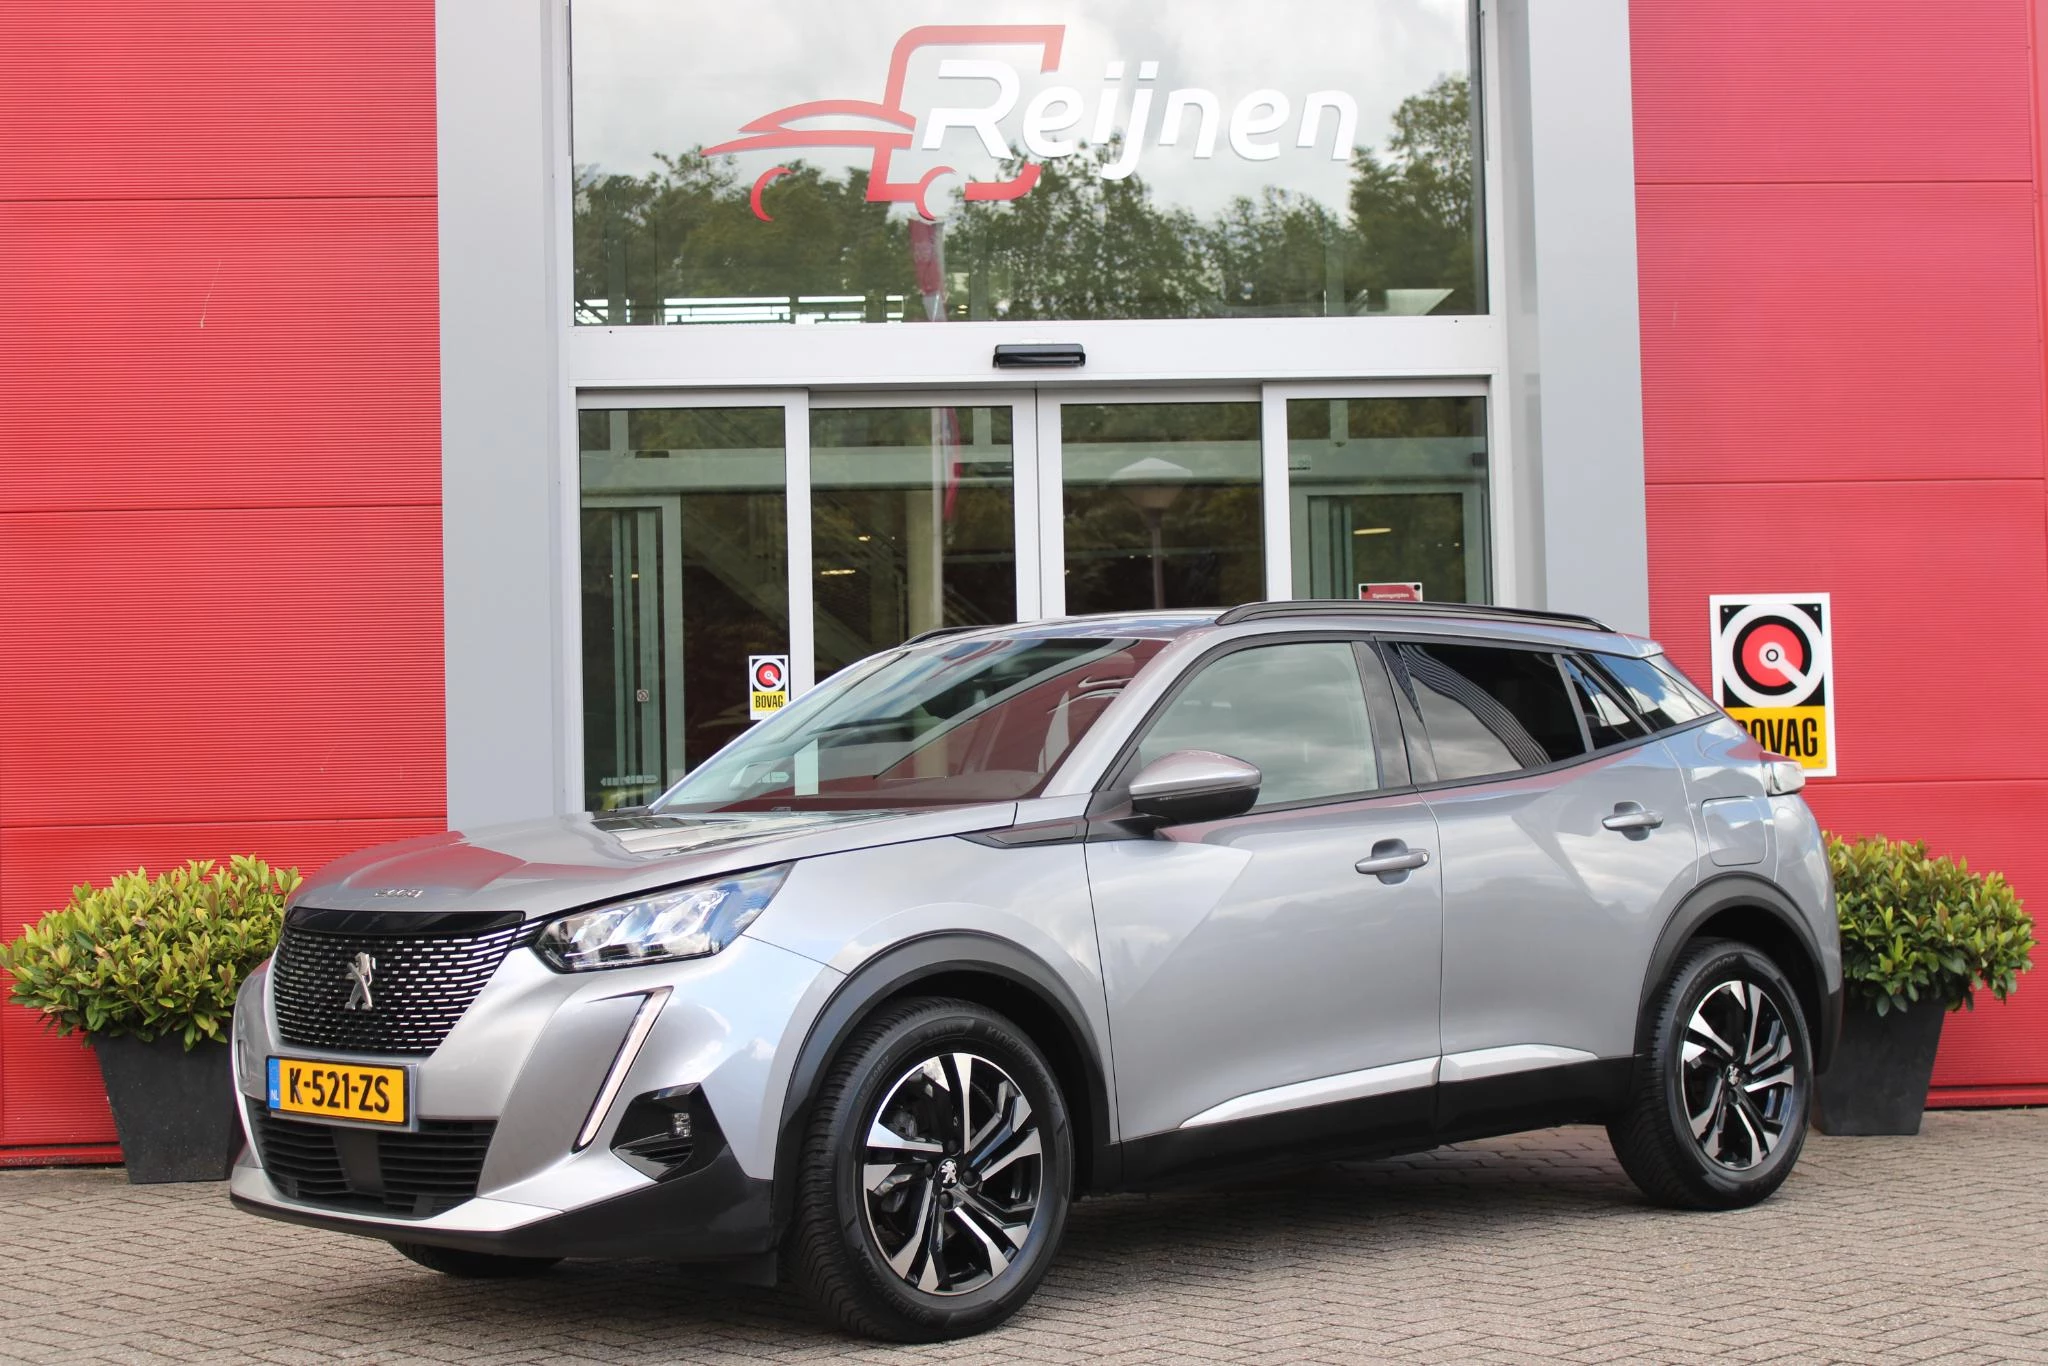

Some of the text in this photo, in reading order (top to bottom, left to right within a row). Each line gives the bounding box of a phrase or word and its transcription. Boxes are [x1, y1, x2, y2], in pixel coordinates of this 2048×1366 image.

[921, 59, 1359, 180] Reijnen
[755, 694, 784, 709] BOVAG
[1736, 717, 1818, 757] OVAG
[289, 1067, 390, 1113] K-521-ZS
